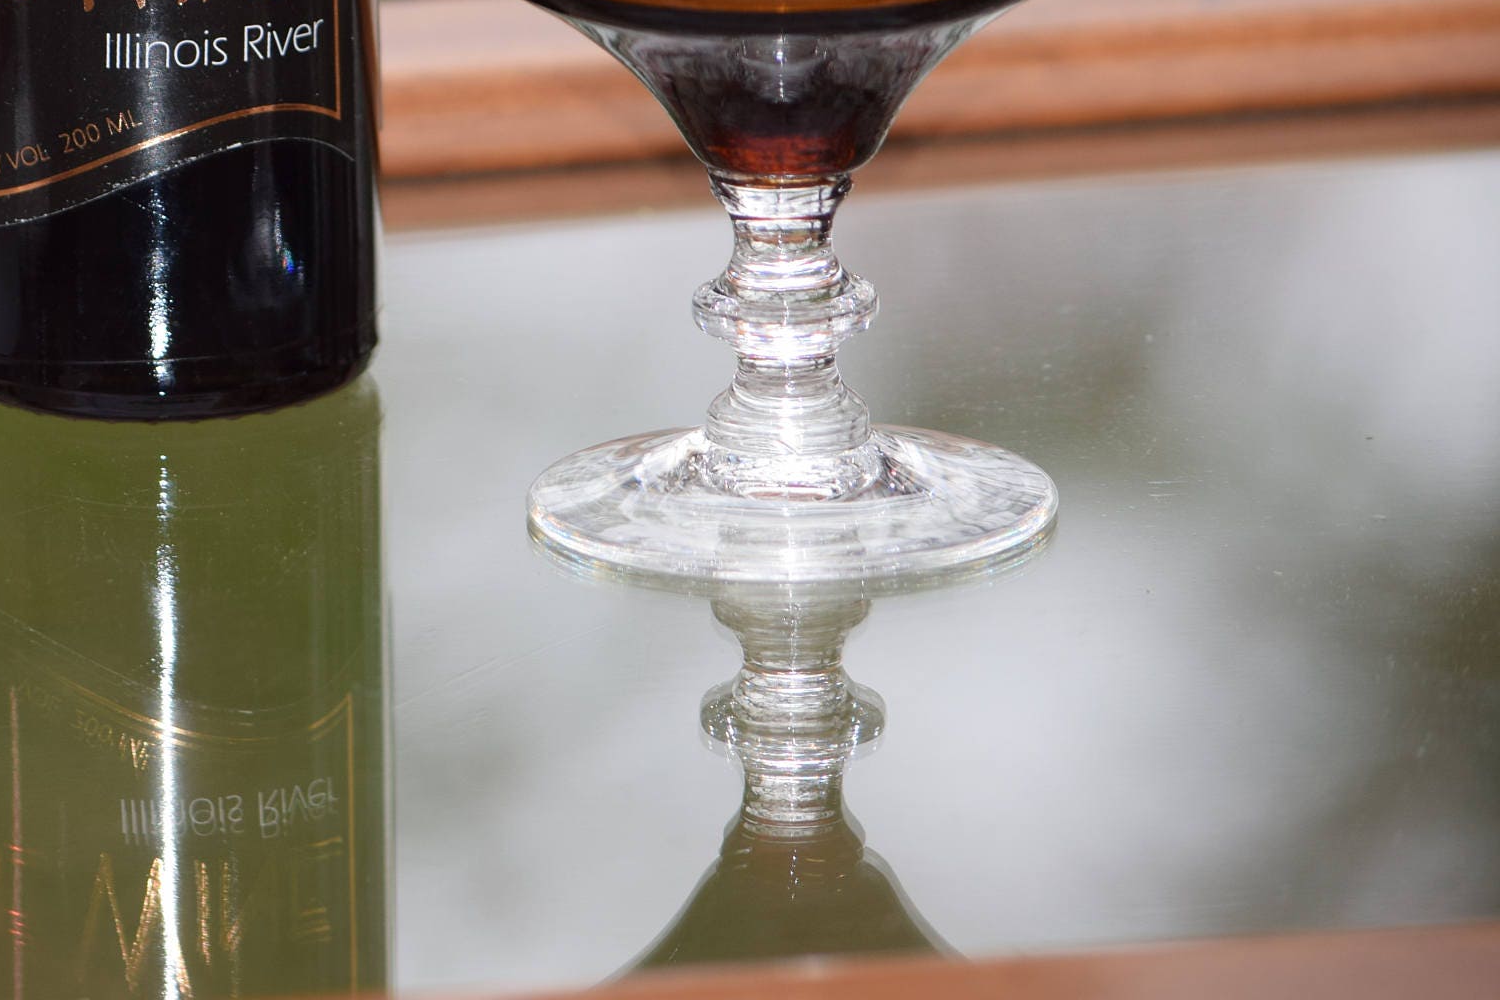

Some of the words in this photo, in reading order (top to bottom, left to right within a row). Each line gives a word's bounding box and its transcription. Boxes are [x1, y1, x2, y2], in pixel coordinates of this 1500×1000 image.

[105, 31, 228, 71] Illinois
[243, 18, 324, 63] River
[58, 122, 101, 153] 200
[105, 109, 143, 136] ML
